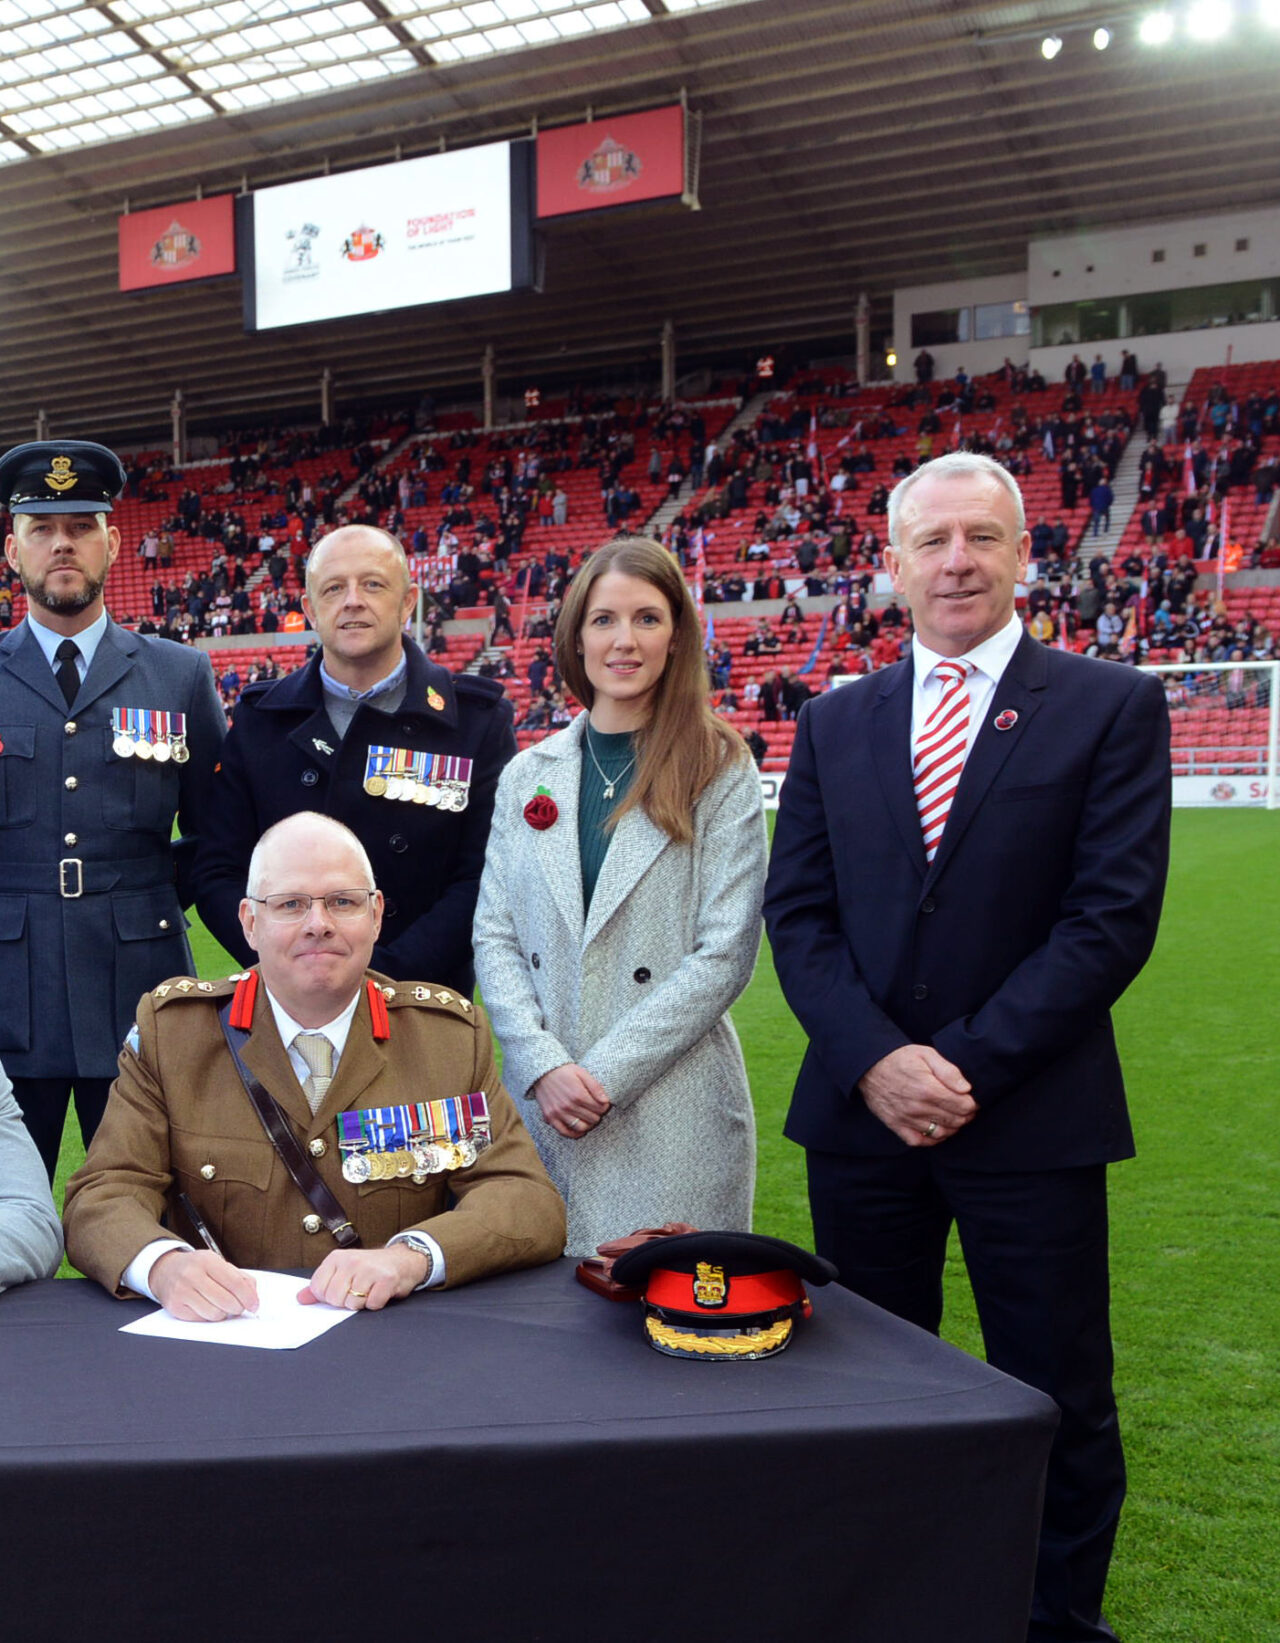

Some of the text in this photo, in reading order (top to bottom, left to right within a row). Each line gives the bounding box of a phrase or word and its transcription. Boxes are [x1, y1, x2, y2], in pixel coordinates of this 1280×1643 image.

[407, 209, 475, 226] FOUNDATION
[407, 219, 454, 238] OF LIGHT
